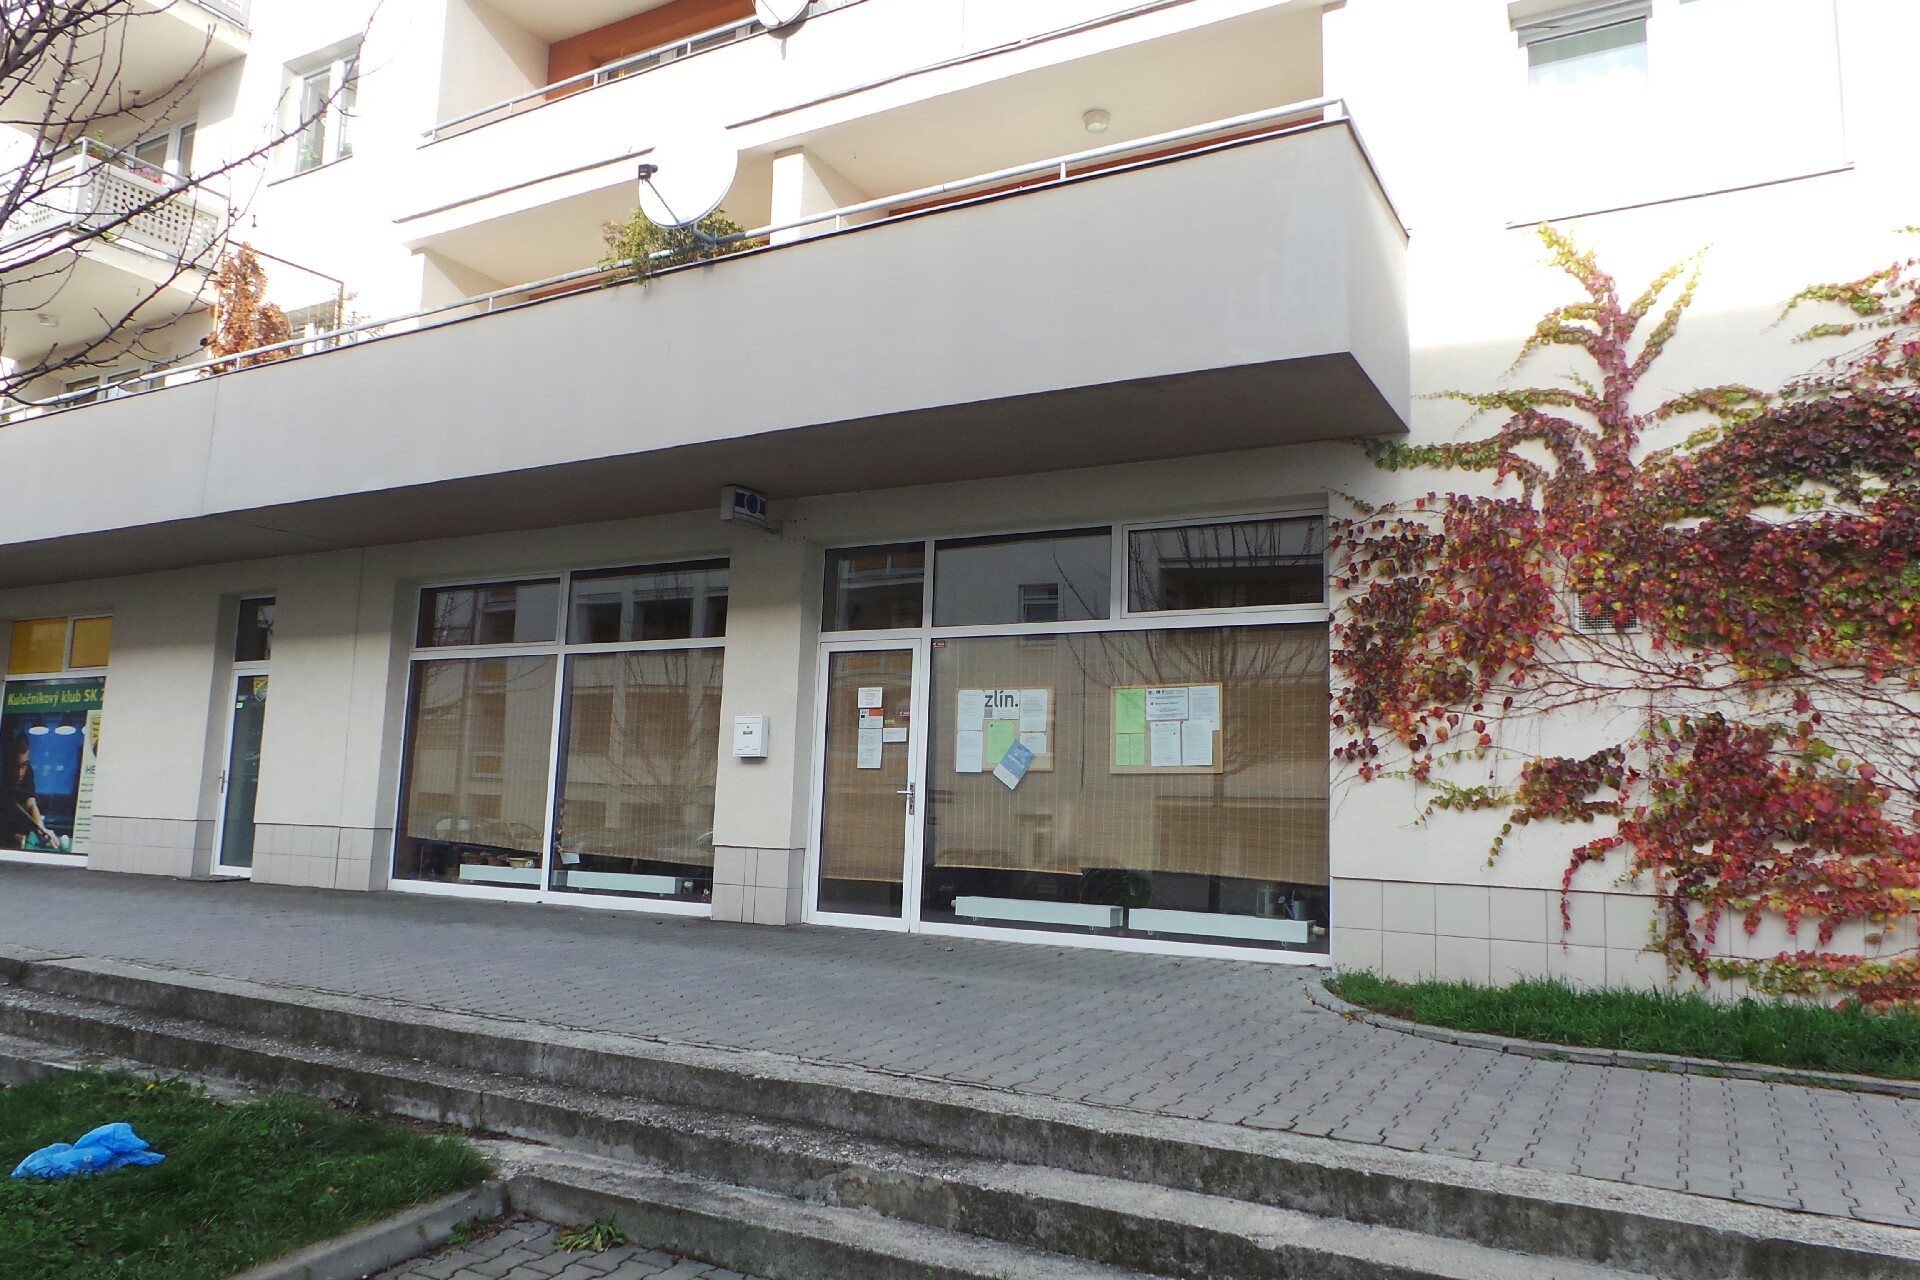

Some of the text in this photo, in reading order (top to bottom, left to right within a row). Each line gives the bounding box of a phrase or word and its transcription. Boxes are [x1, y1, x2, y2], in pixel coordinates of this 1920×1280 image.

[61, 690, 81, 703] klub
[84, 688, 98, 702] SK
[984, 690, 1018, 708] zlín.
